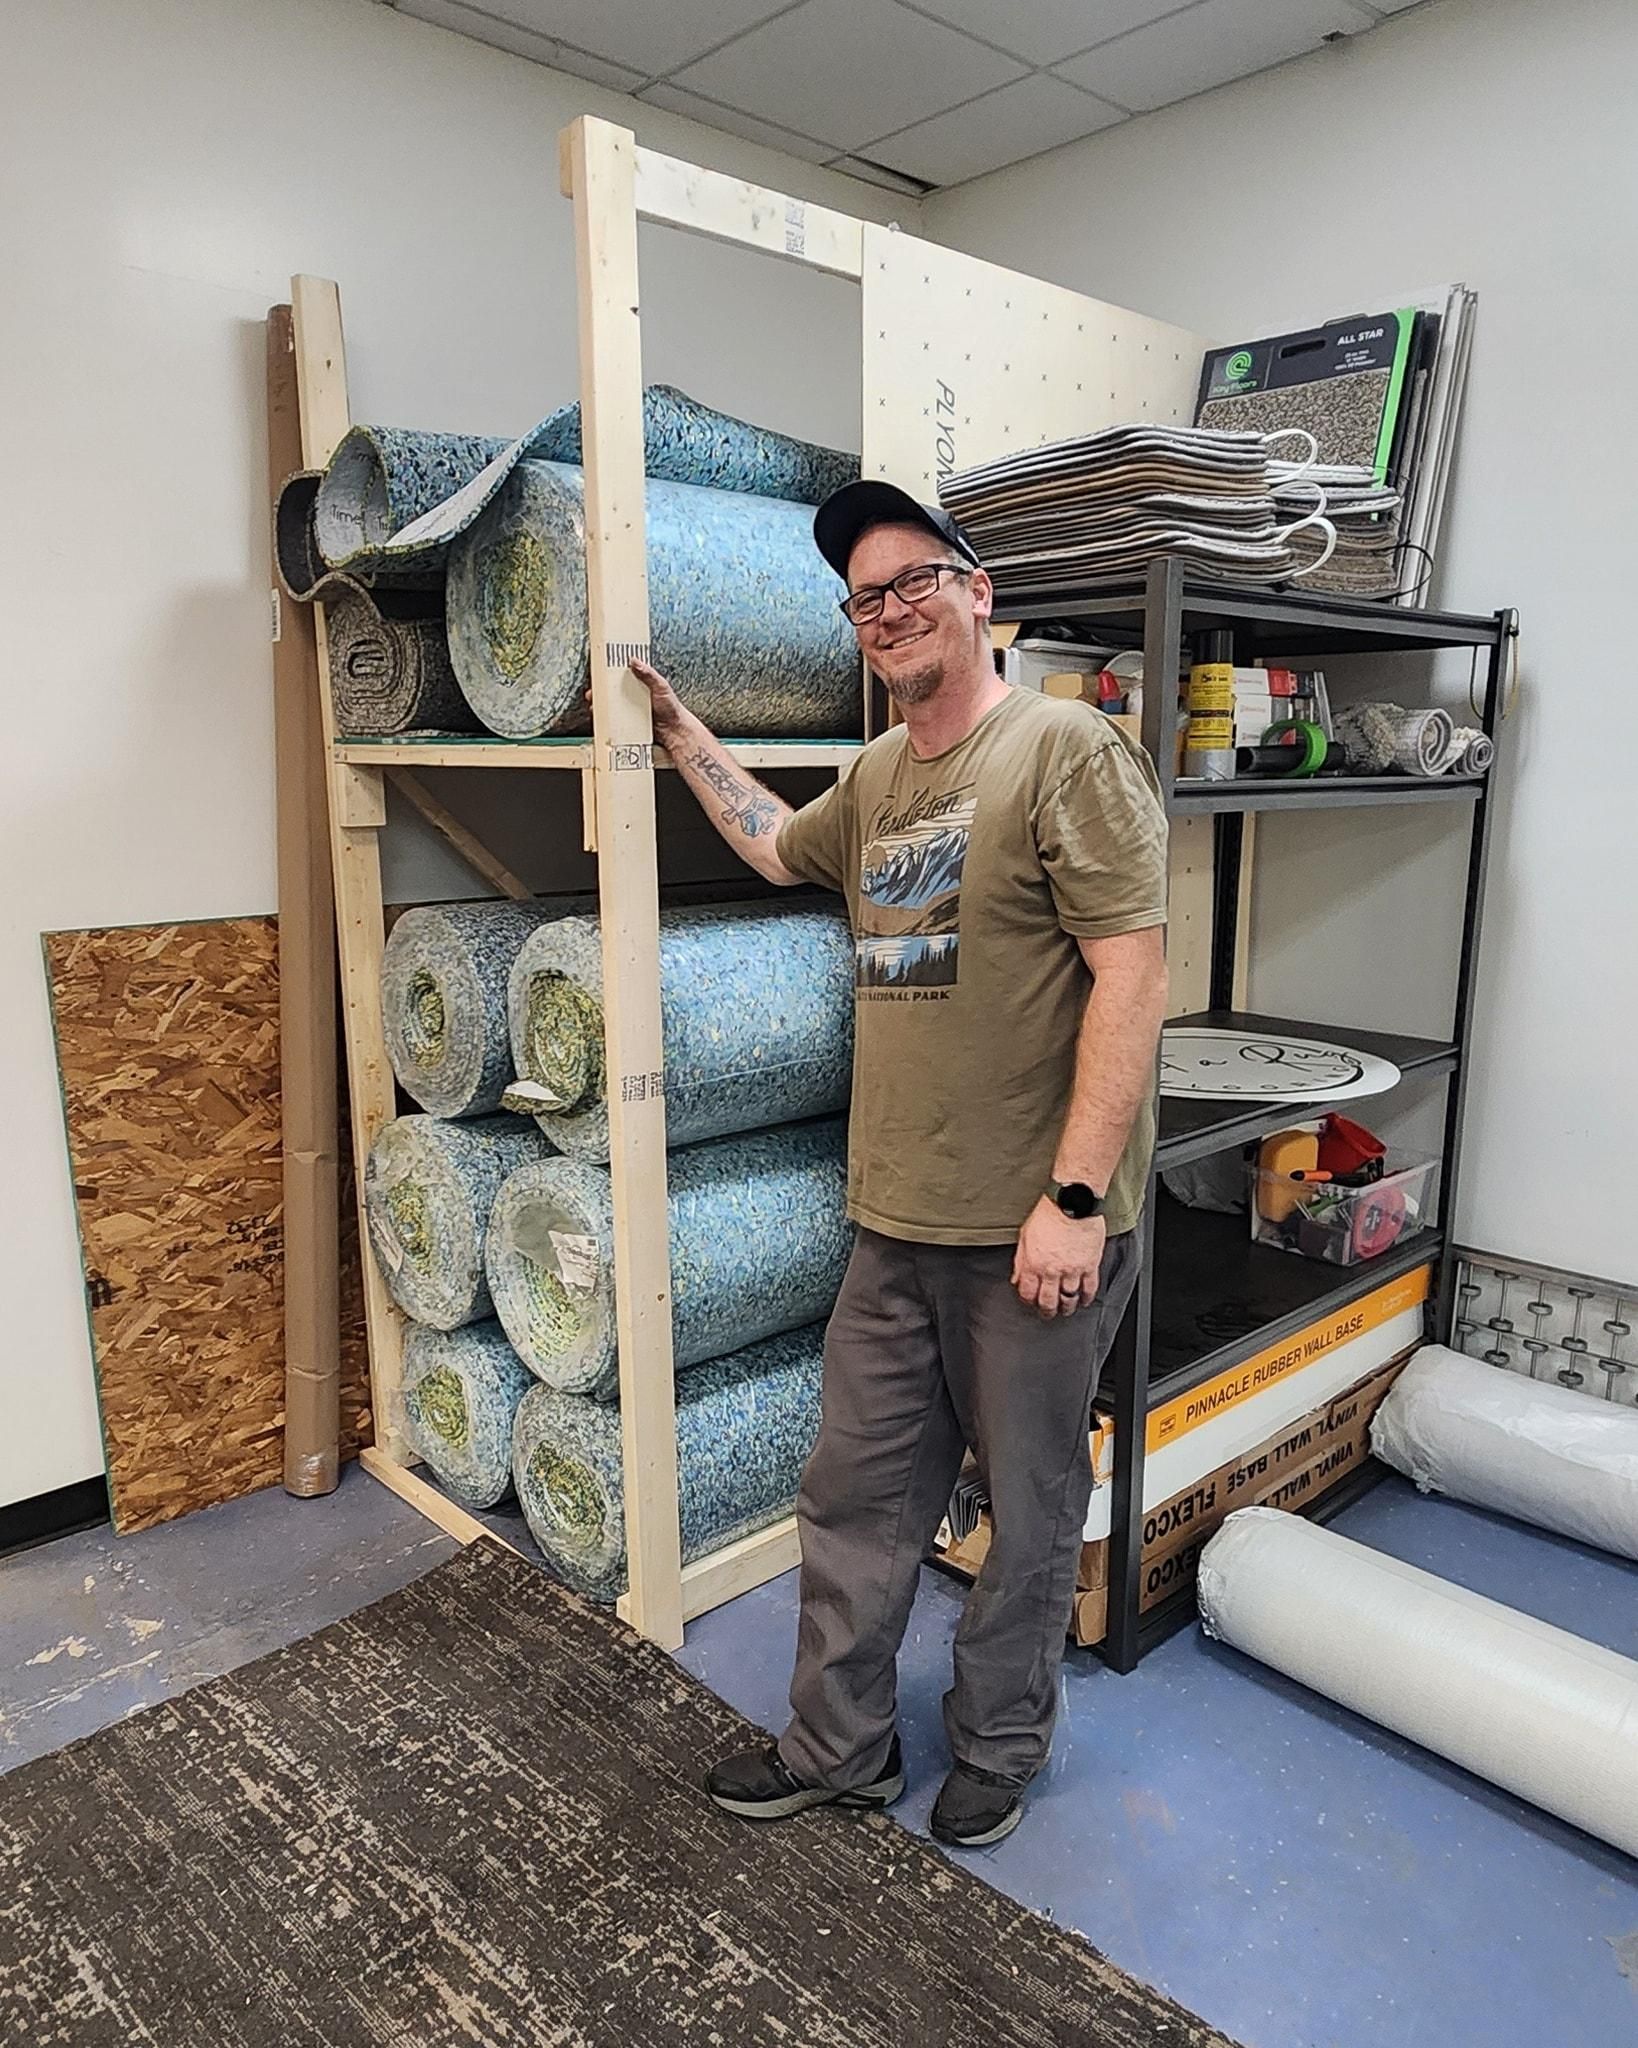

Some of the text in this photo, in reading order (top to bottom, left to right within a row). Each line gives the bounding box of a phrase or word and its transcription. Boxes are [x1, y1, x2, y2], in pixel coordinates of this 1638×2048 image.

[1337, 327, 1384, 346] ALL STAR
[936, 378, 955, 494] PLYON
[912, 989, 951, 1002] PARK
[1186, 1313, 1364, 1423] PINNACLE RUBBER WALL BASE
[1144, 1402, 1358, 1545] VINYL WALL BASE FLEXCO
[1147, 1440, 1354, 1594] VINYL WALL EXCO
